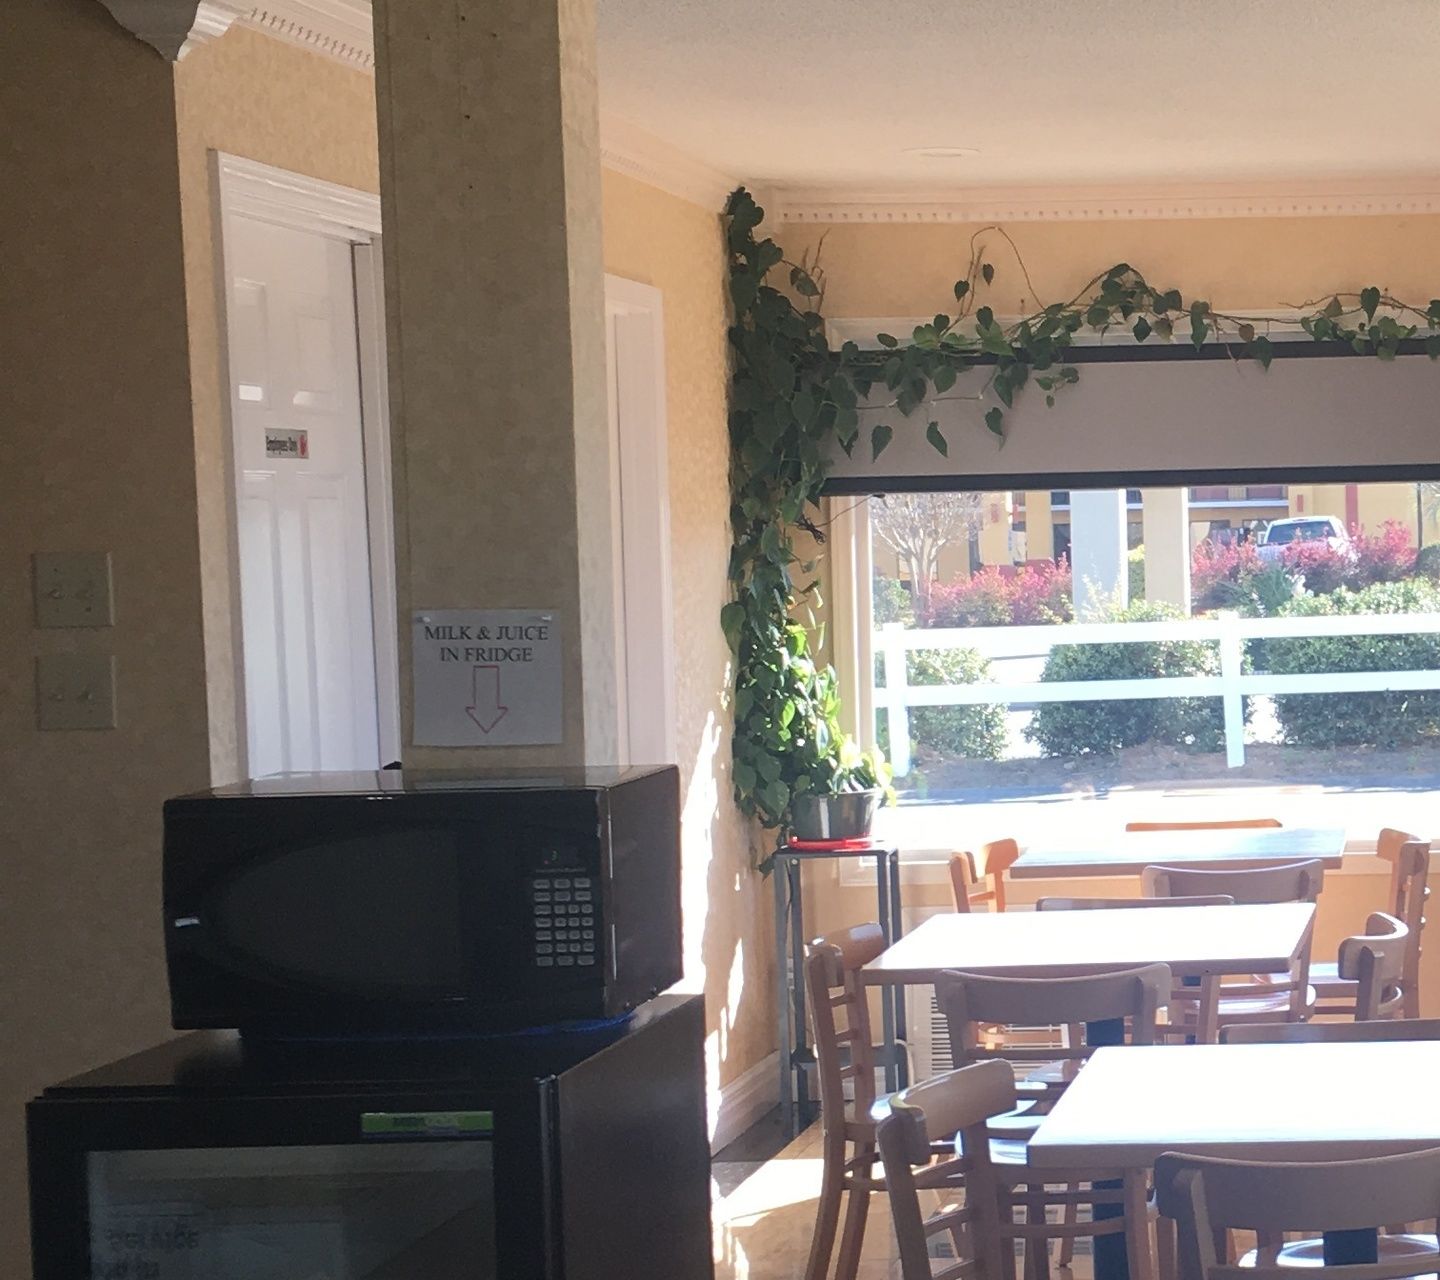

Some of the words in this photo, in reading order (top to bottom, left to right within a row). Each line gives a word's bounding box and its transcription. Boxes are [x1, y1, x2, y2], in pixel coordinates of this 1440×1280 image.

[425, 626, 472, 641] MILK
[476, 626, 491, 641] &
[496, 626, 549, 641] JUICE
[440, 647, 459, 662] IN
[465, 647, 534, 662] FRIDGE
